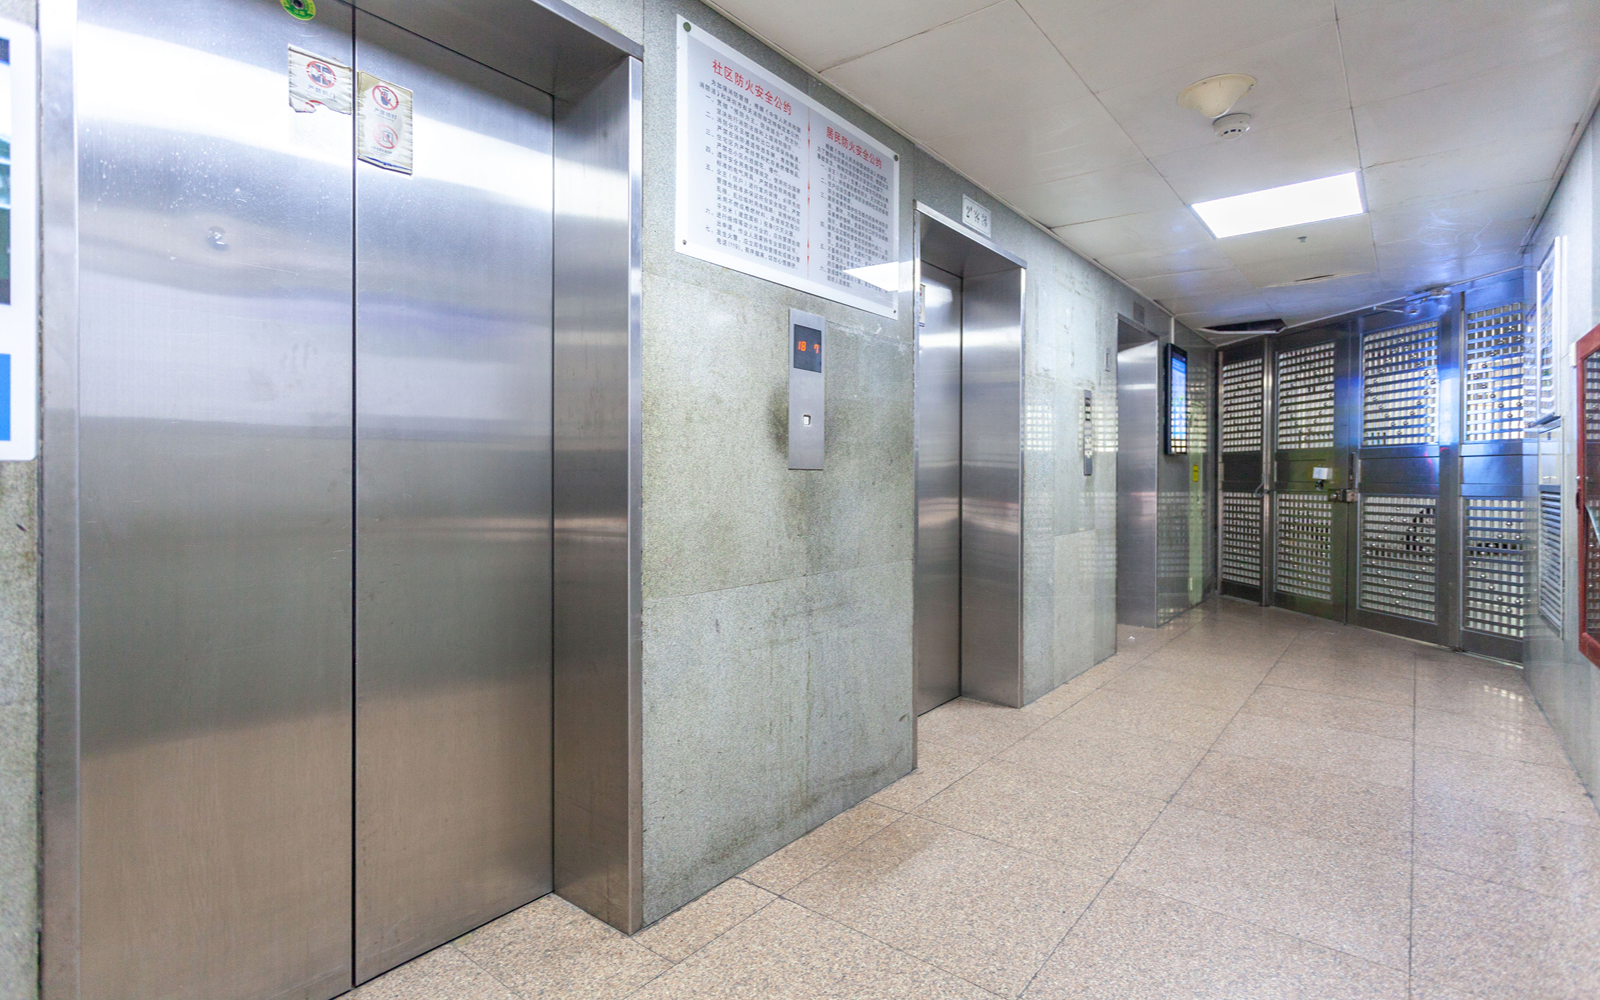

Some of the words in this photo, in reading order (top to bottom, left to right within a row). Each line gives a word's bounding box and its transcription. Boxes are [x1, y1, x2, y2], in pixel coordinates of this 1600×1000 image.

[712, 58, 791, 116] 社区防火安全公约
[826, 126, 882, 169] 居民防火安全公约
[798, 341, 807, 352] 18
[814, 344, 820, 354] 7
